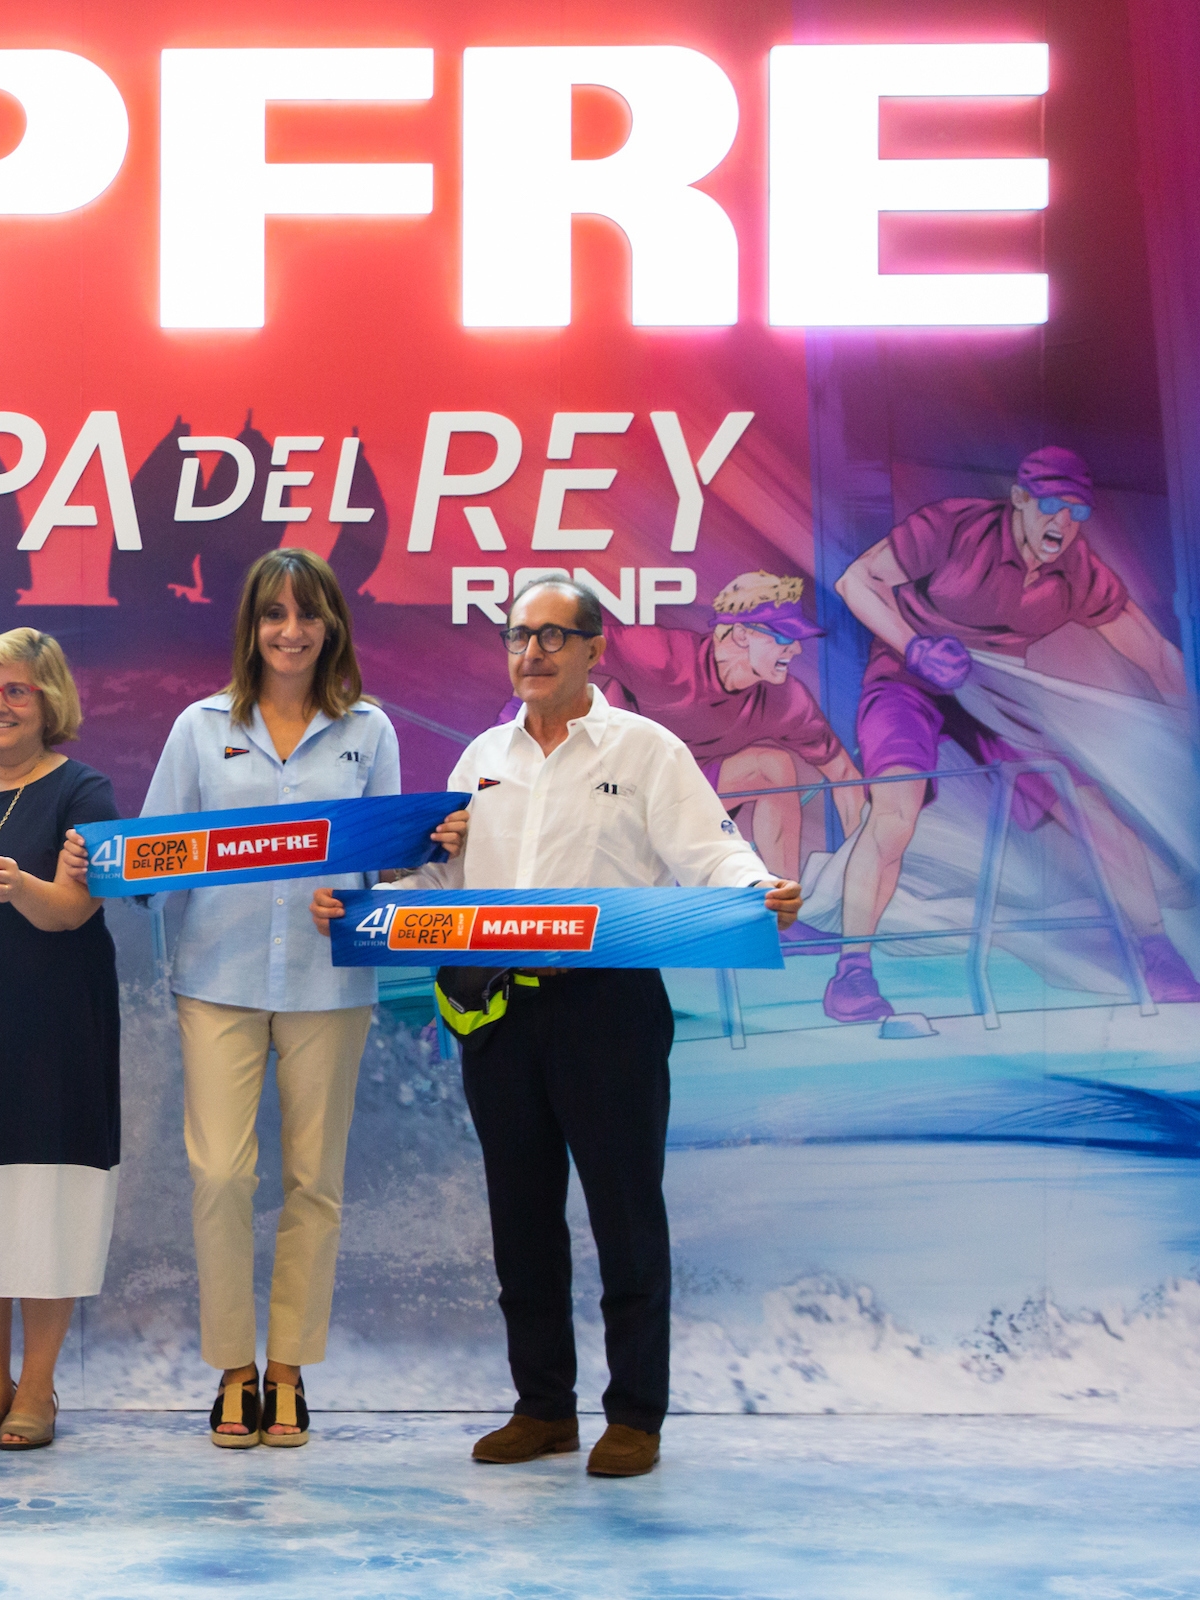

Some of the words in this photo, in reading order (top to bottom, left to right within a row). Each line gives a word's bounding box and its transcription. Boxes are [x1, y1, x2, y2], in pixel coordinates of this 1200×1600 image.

[173, 436, 375, 522] DEL
[406, 411, 755, 552] REY
[90, 835, 123, 872] 41
[137, 840, 187, 857] COPA
[217, 833, 318, 857] MAPFRE
[132, 859, 151, 869] DEL
[153, 855, 187, 872] REY
[355, 903, 396, 939] 41
[404, 913, 453, 928] COPA
[482, 920, 584, 935] MAPFRE
[397, 929, 416, 939] DEL
[417, 929, 453, 944] REY
